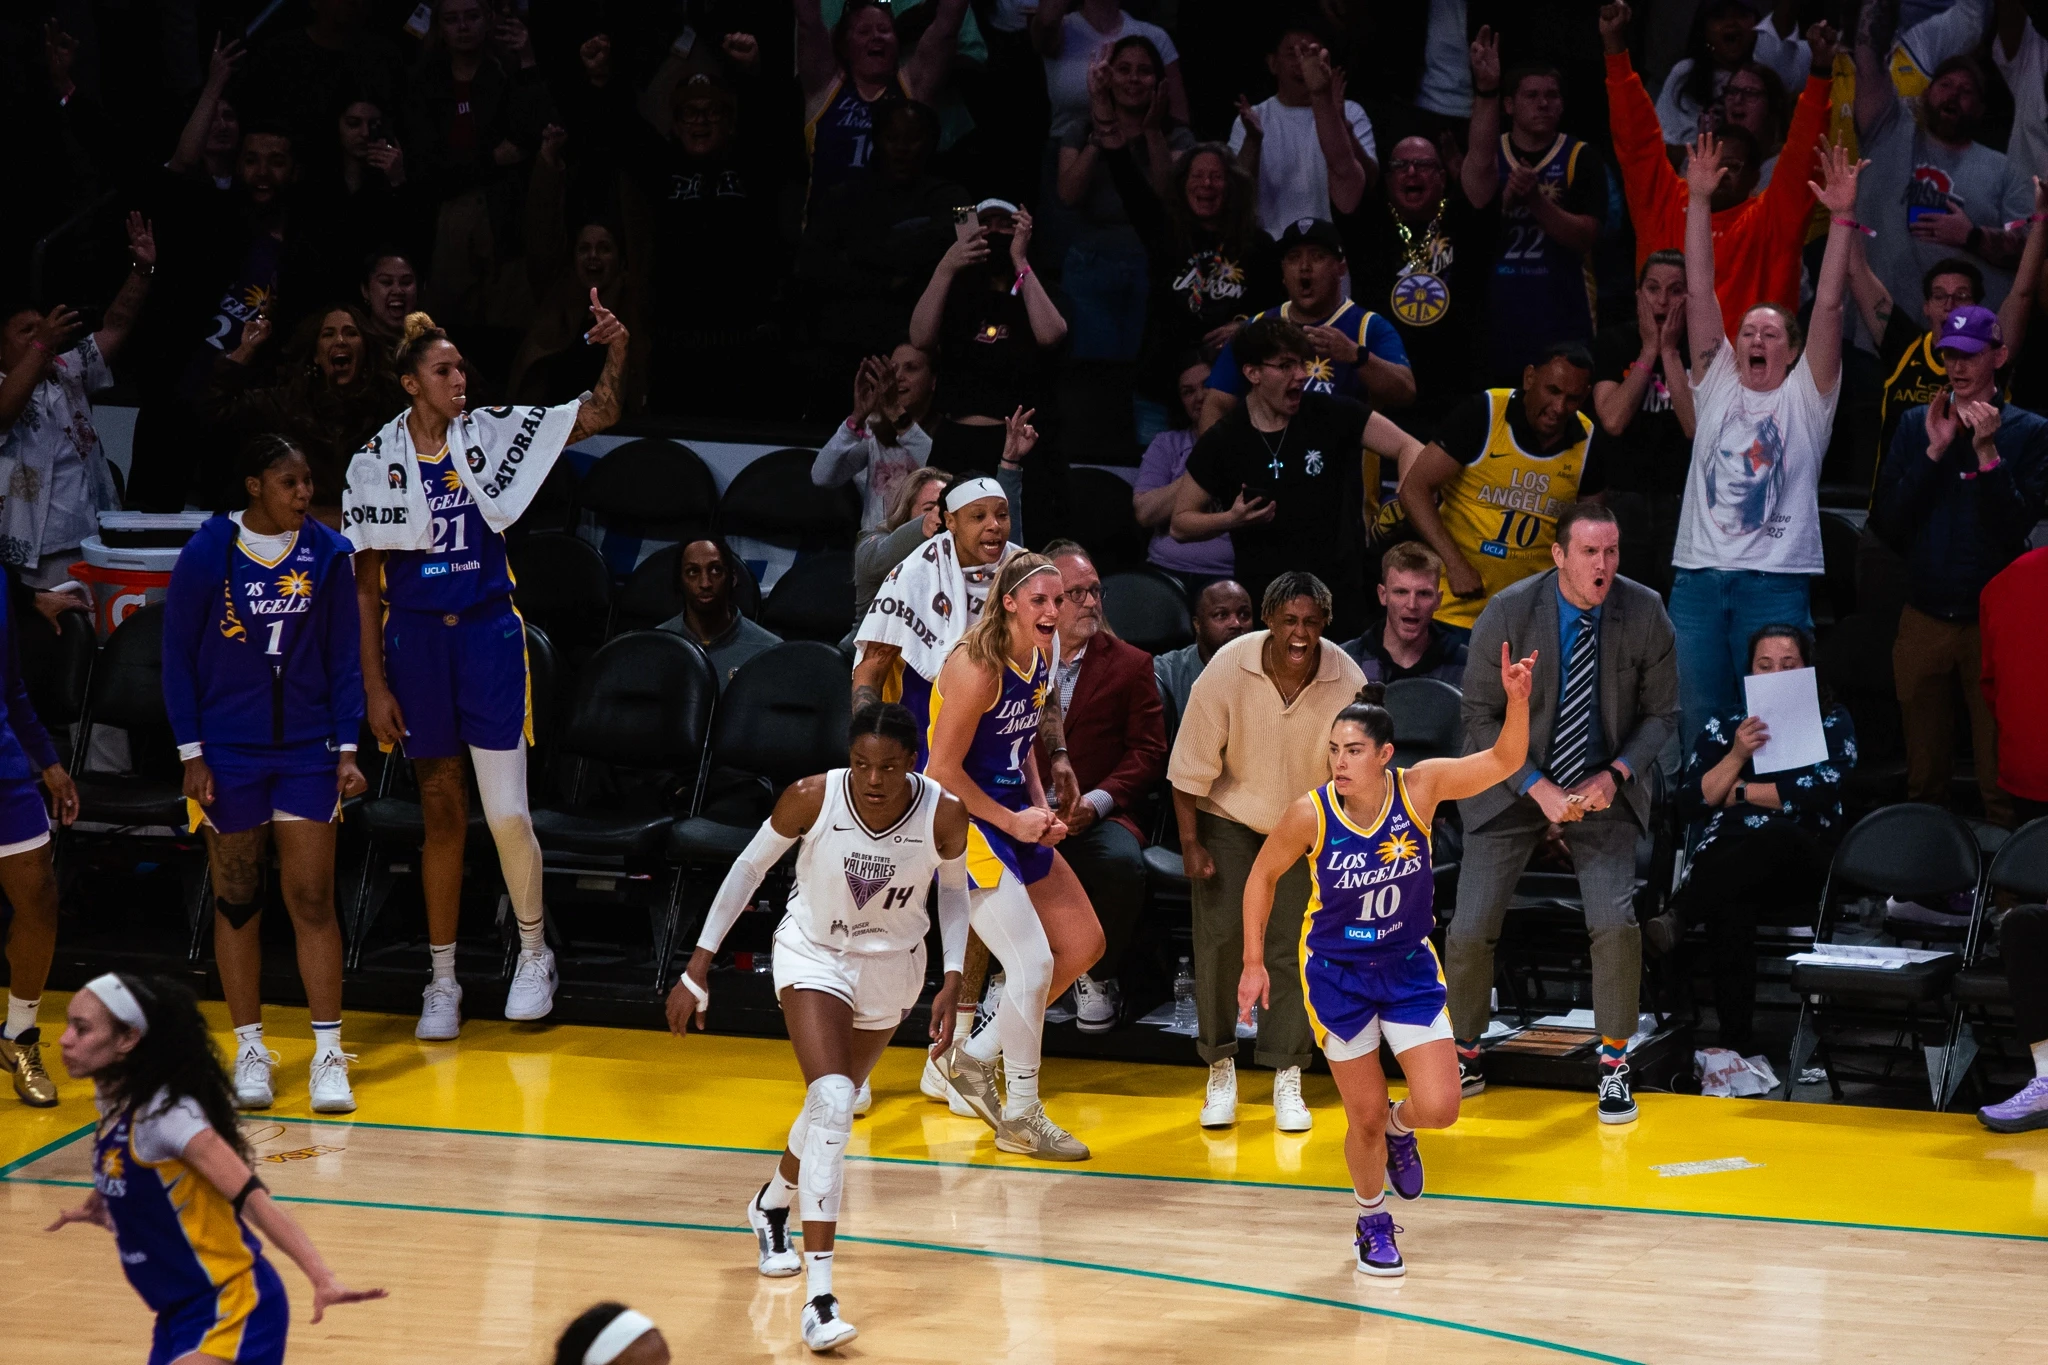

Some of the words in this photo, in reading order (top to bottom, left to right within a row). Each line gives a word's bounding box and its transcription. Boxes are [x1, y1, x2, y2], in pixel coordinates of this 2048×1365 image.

[1504, 224, 1545, 260] 22
[1510, 467, 1551, 494] LOS
[426, 513, 469, 554] 21
[1495, 510, 1541, 549] 10
[1483, 543, 1505, 555] UCLA
[424, 565, 447, 575] UCLA
[450, 559, 481, 573] Health
[263, 619, 285, 656] 1
[995, 698, 1028, 720] LOS
[1390, 820, 1411, 834] Albert
[844, 856, 897, 880] VALKYRIES
[851, 851, 873, 863] GOLDEN
[873, 855, 891, 864] STATE
[1326, 850, 1369, 872] LOS
[1333, 855, 1423, 890] ANGELES
[882, 885, 915, 911] 14
[1355, 884, 1402, 922] 10
[1348, 928, 1373, 940] UCLA
[1376, 920, 1404, 940] Health
